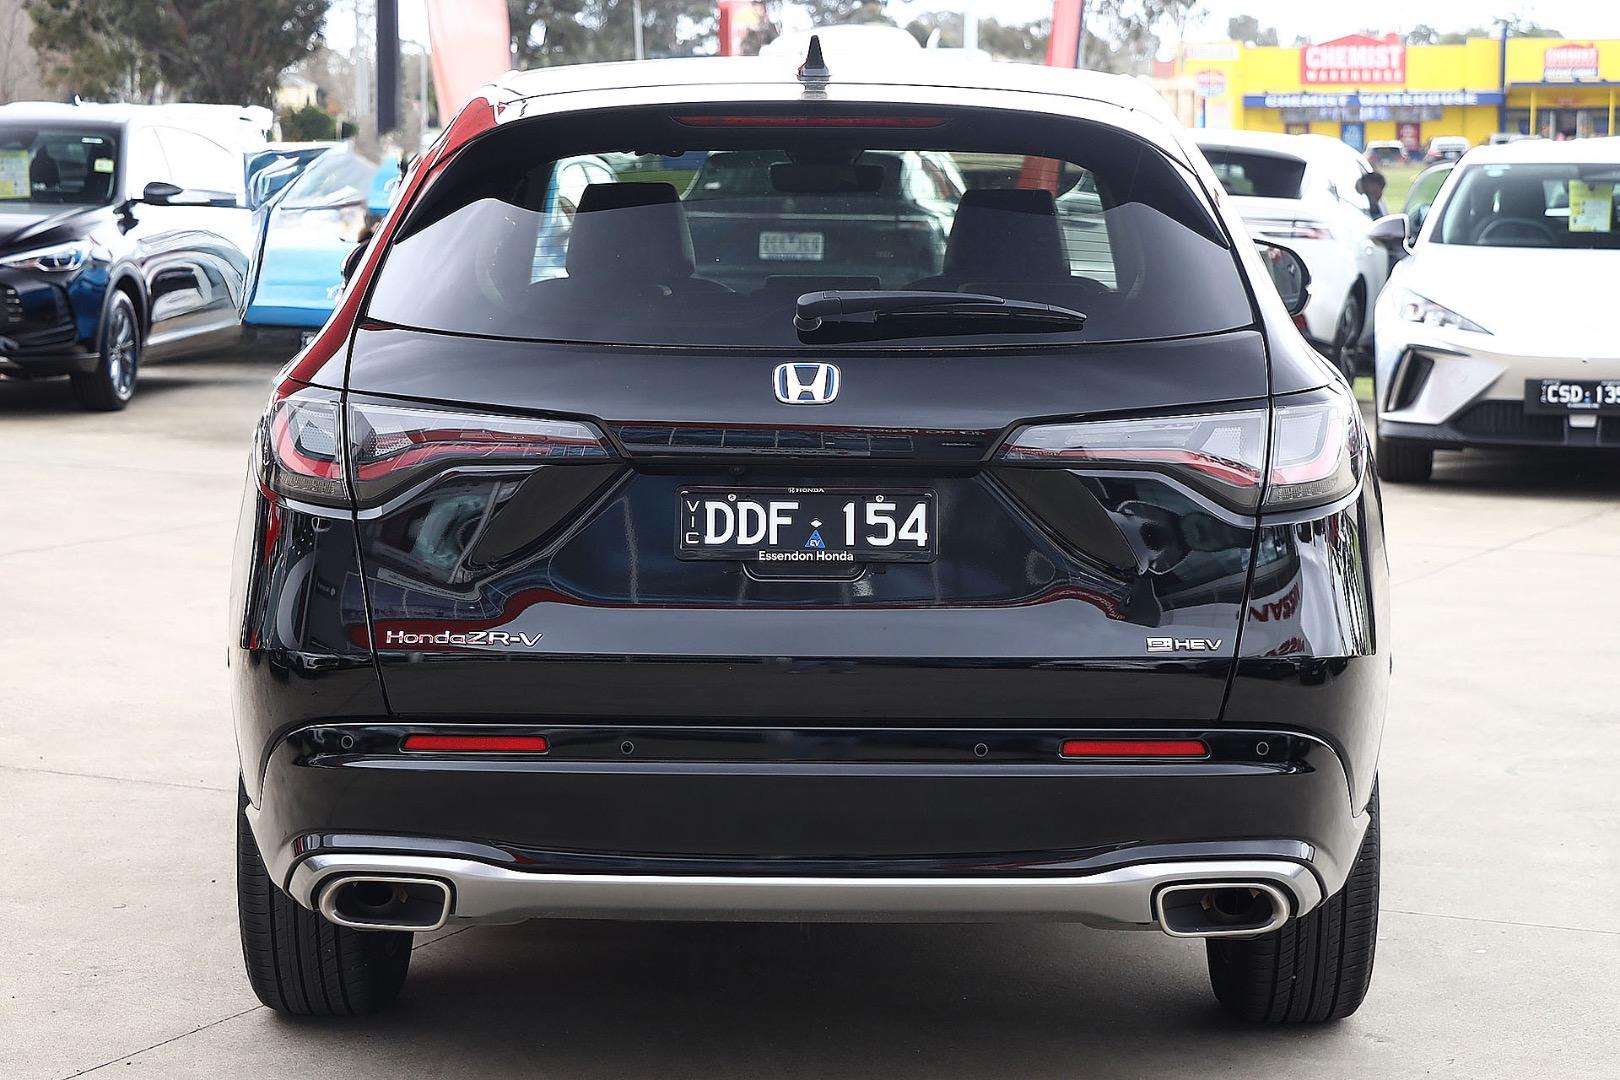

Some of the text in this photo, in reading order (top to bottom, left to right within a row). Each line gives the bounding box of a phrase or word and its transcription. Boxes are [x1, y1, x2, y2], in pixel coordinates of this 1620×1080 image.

[1305, 45, 1404, 69] CHEMIST
[1546, 384, 1584, 403] CSD
[703, 500, 929, 548] DDF 154
[758, 550, 854, 562] Essendon Honda
